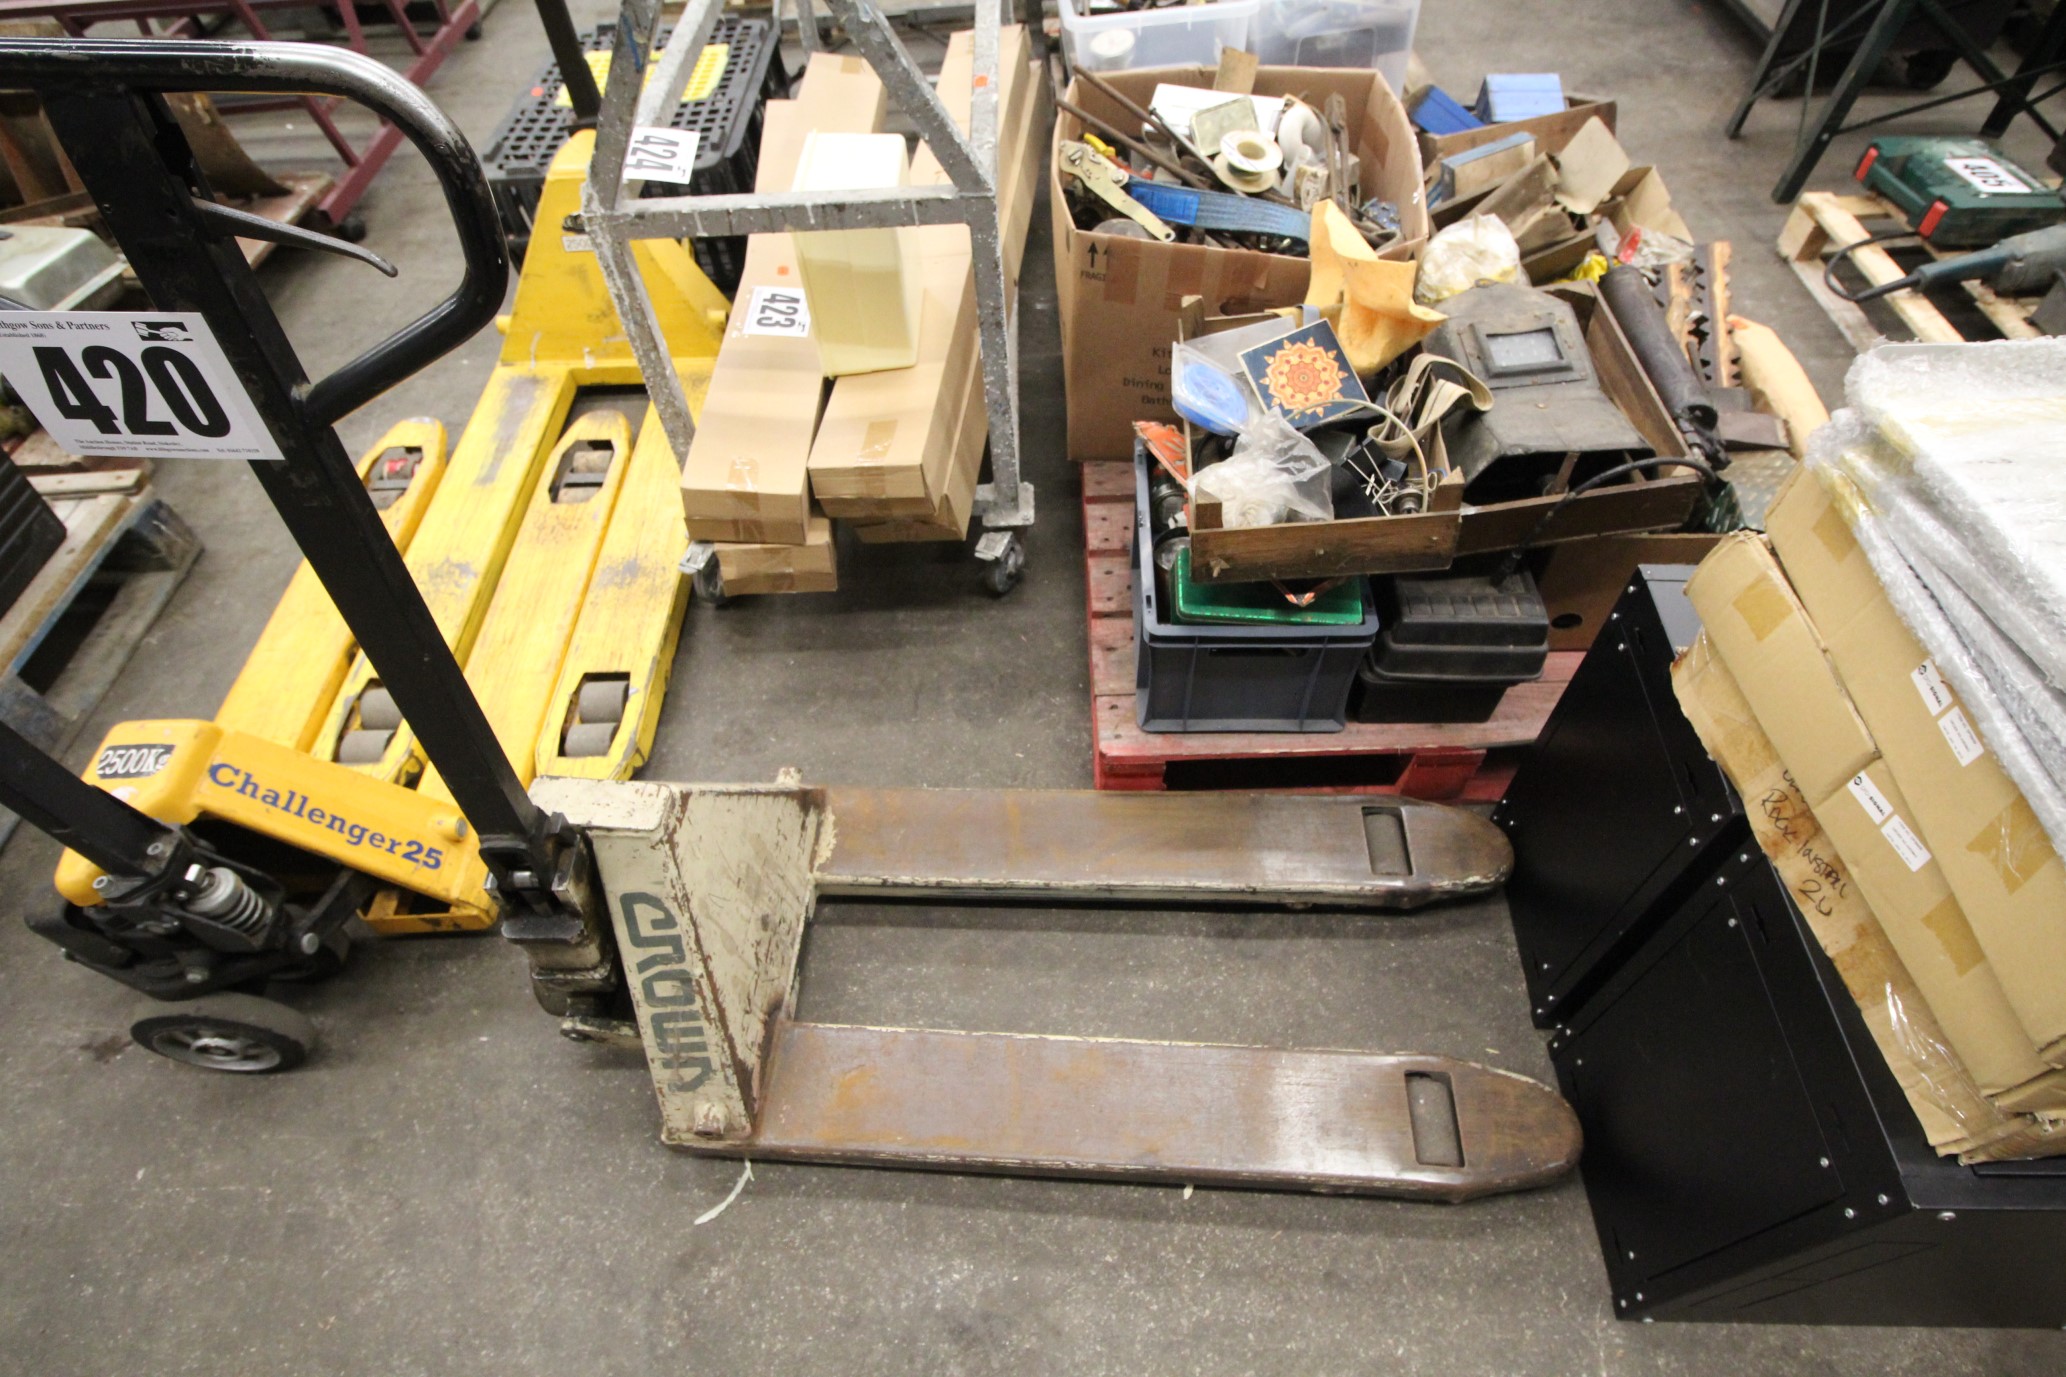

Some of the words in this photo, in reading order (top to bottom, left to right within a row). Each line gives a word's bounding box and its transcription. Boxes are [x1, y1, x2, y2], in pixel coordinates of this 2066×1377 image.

[625, 135, 680, 172] 424
[1080, 270, 1106, 282] FRAGI
[756, 293, 801, 328] 423
[28, 320, 55, 330] Sons
[55, 321, 66, 331] &
[66, 321, 111, 331] Partners
[1158, 364, 1171, 375] Lo
[32, 345, 231, 437] 420
[1123, 377, 1164, 391] Dining
